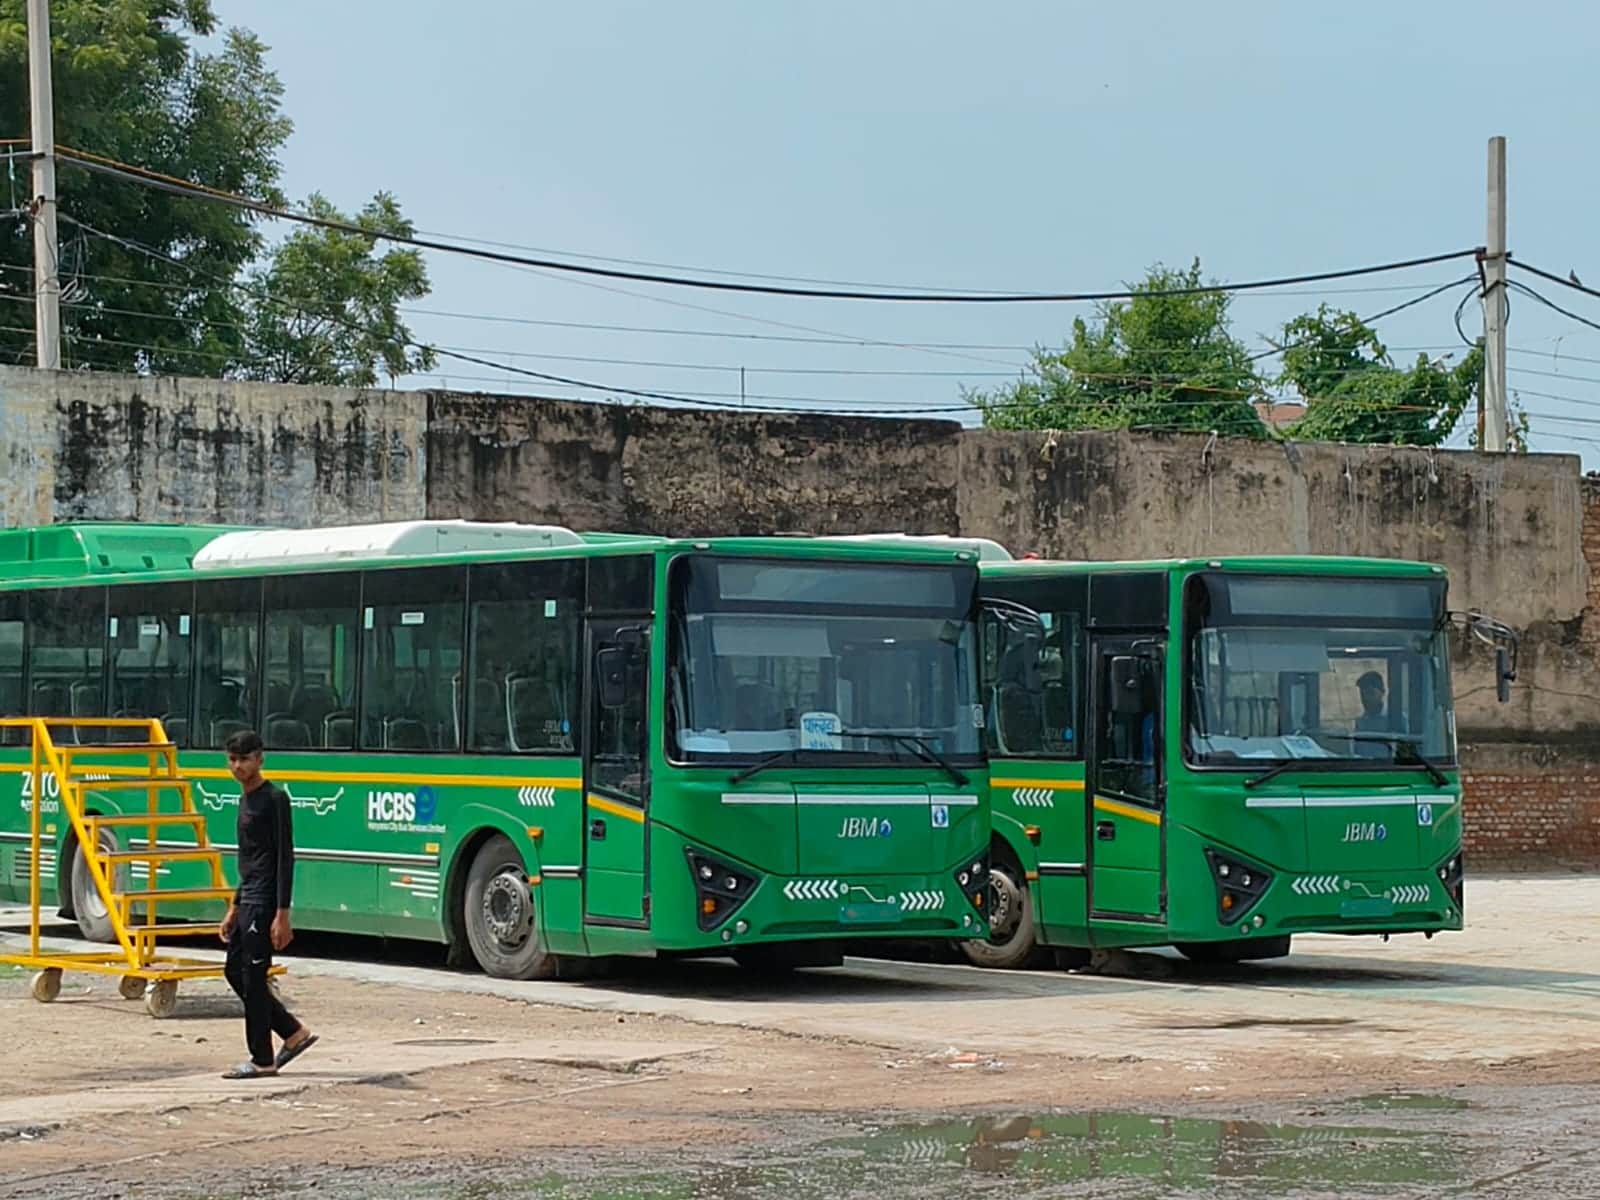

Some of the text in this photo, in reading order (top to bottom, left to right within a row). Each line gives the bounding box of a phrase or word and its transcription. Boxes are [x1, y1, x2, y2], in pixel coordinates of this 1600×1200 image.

[21, 771, 60, 797] zro
[837, 816, 878, 838] JBM
[1341, 822, 1376, 842] JBM
